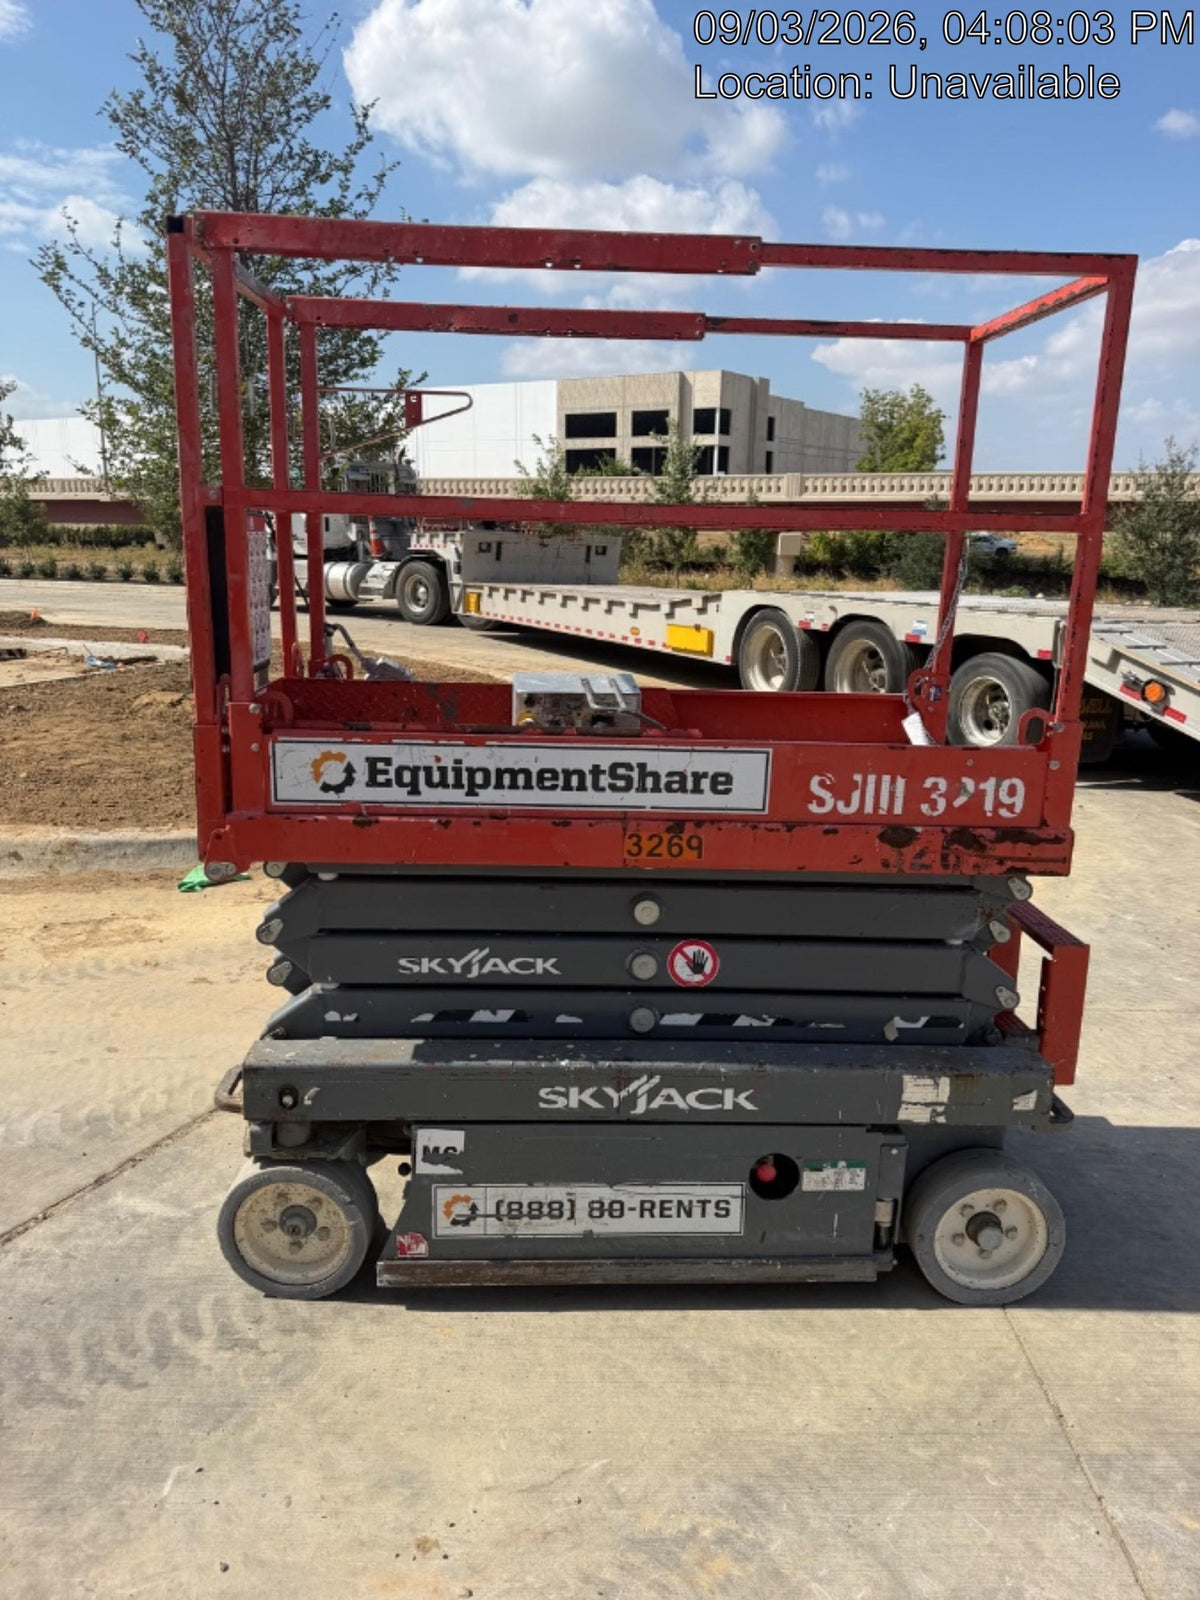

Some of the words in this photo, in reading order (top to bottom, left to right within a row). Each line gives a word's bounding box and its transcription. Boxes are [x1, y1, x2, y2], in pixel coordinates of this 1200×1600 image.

[365, 756, 734, 796] EquipmentShare
[626, 833, 703, 859] 3269
[398, 947, 561, 979] SKYJACK
[538, 1074, 758, 1115] SKYJACK
